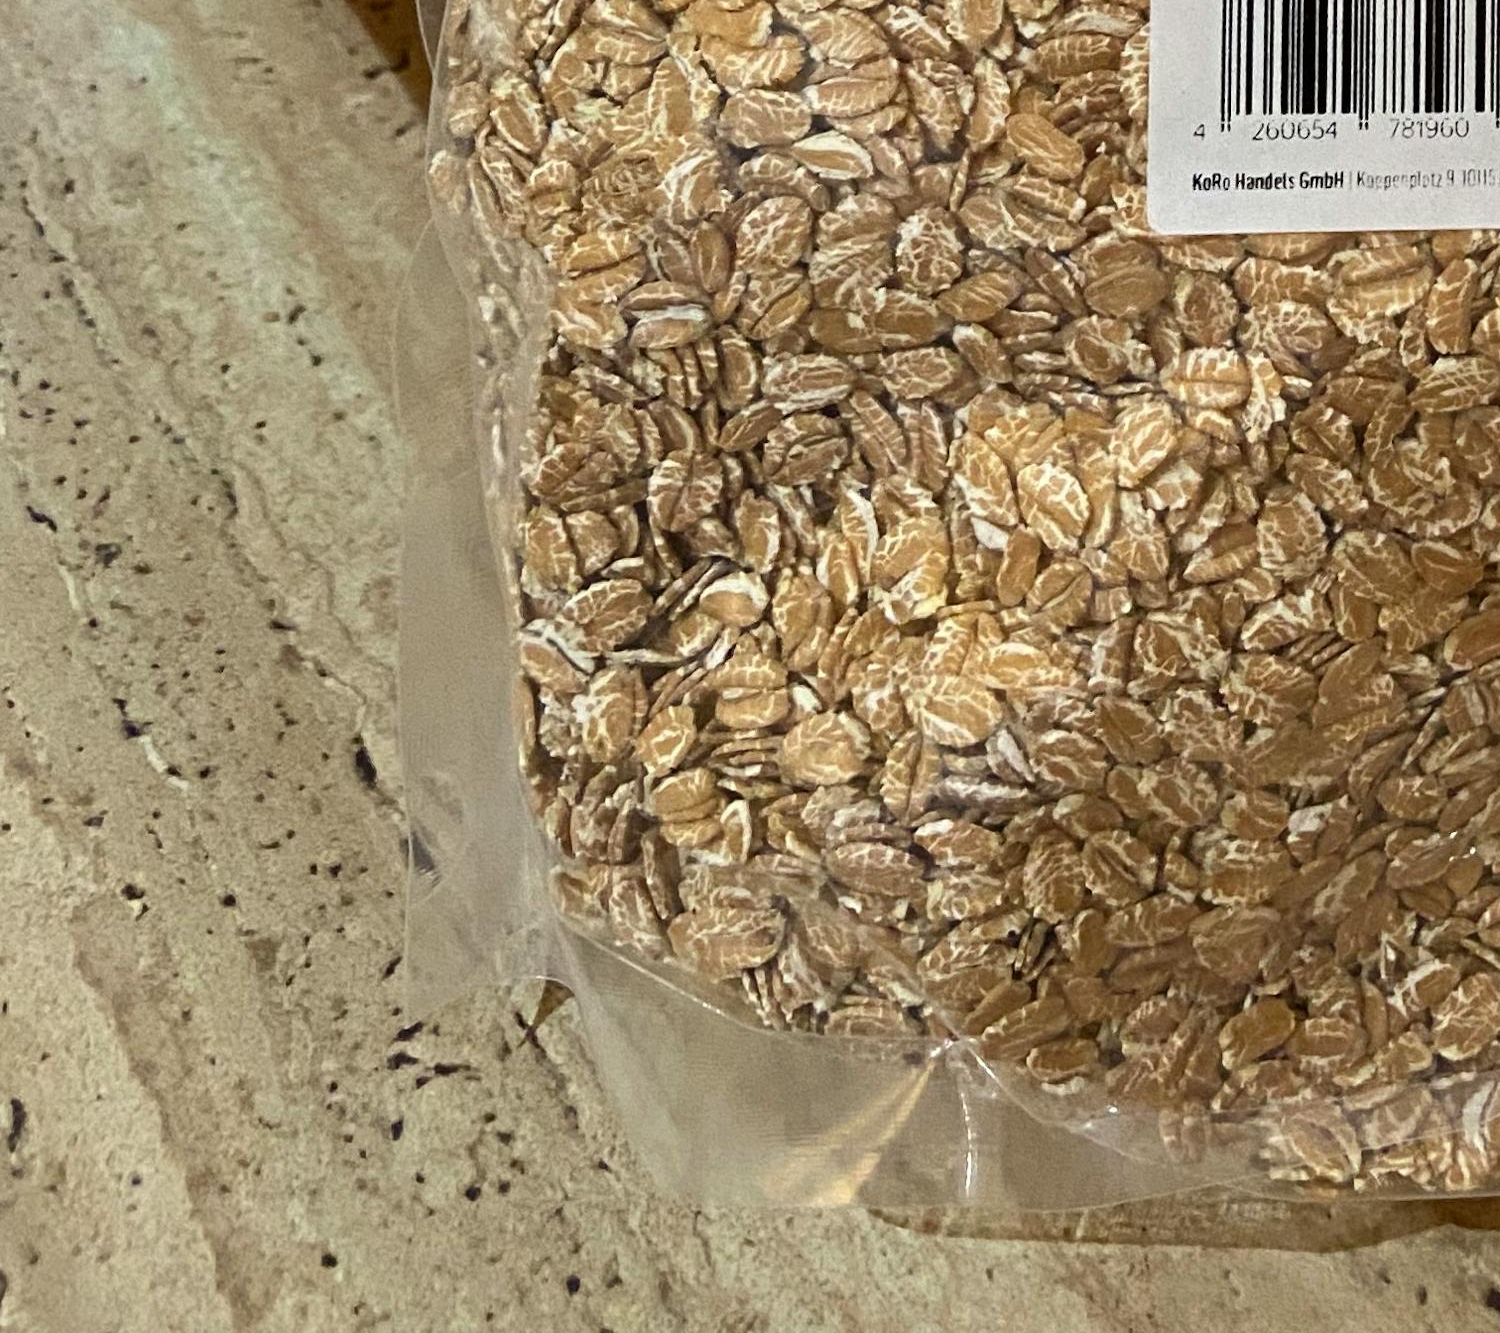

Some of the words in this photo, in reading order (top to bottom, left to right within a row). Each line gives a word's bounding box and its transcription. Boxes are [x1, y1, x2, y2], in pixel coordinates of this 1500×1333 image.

[1252, 119, 1337, 141] 260654
[1390, 117, 1469, 139] 781960
[1192, 173, 1230, 191] KoRo
[1235, 173, 1294, 190] Handels
[1300, 171, 1343, 189] GmbH
